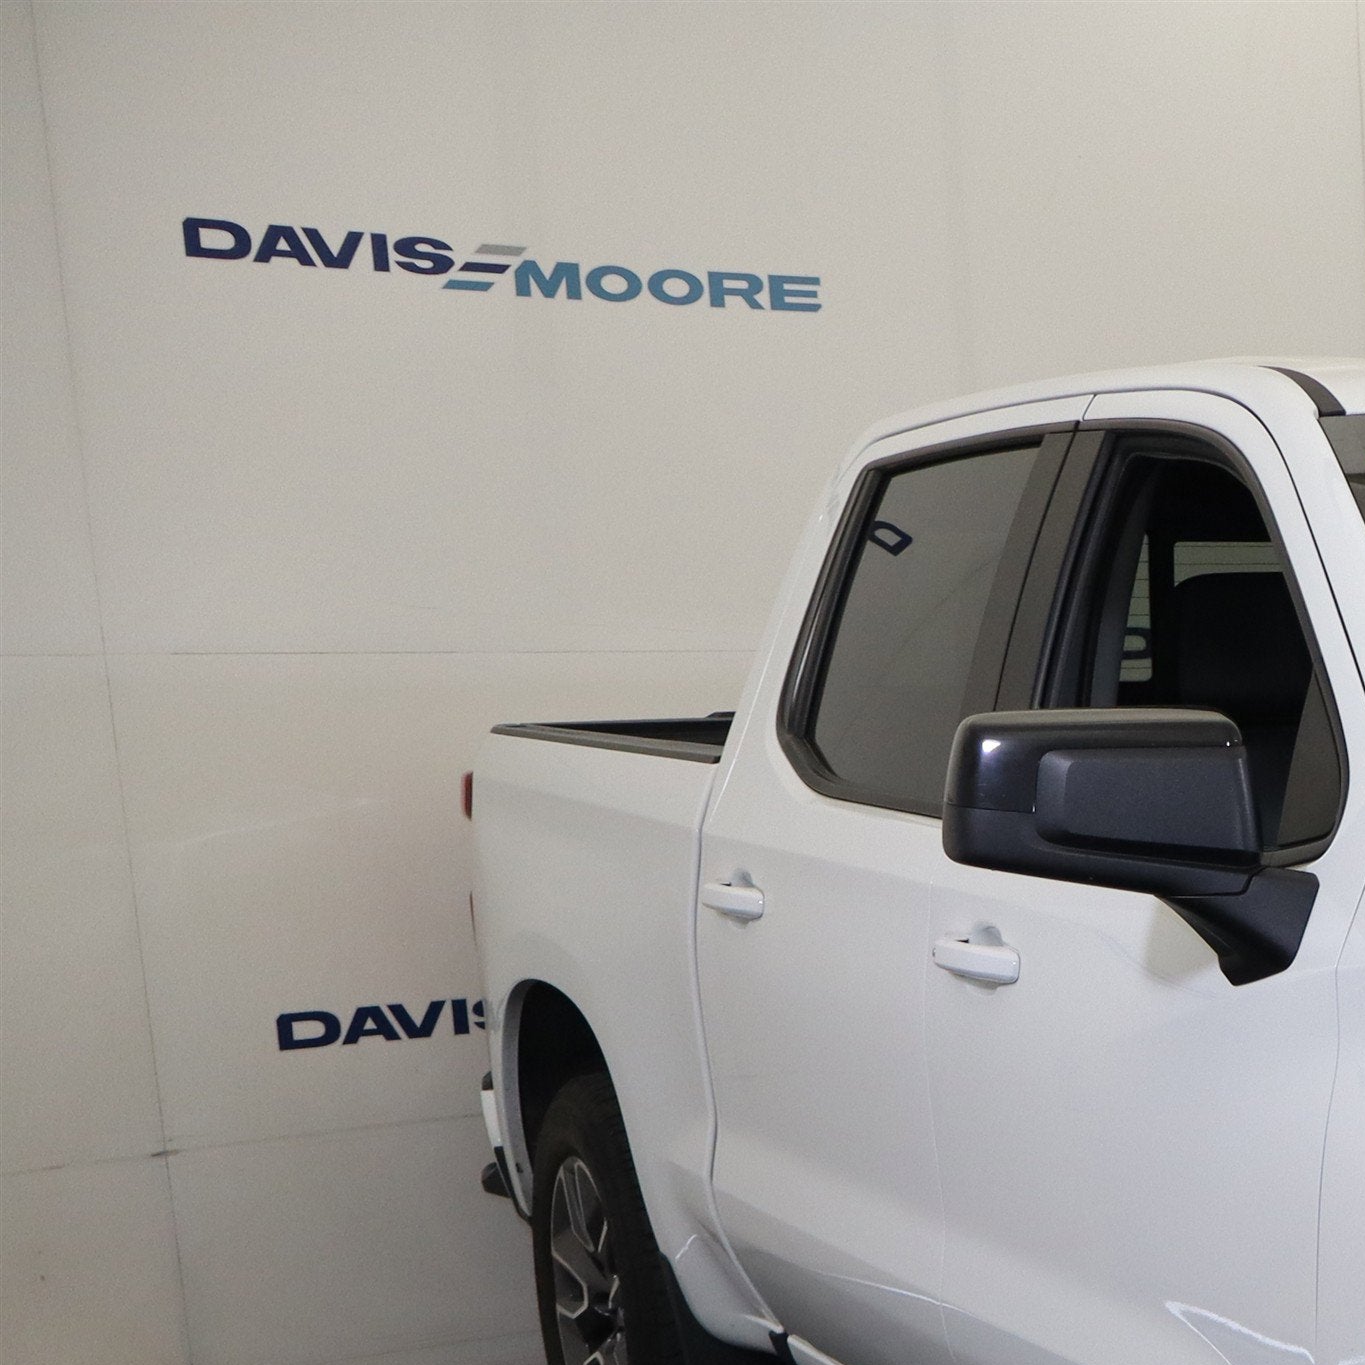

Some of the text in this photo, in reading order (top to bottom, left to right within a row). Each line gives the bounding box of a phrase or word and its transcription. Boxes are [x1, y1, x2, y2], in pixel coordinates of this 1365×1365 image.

[182, 216, 822, 312] DAVIS MOORE
[276, 998, 485, 1050] DAVI
